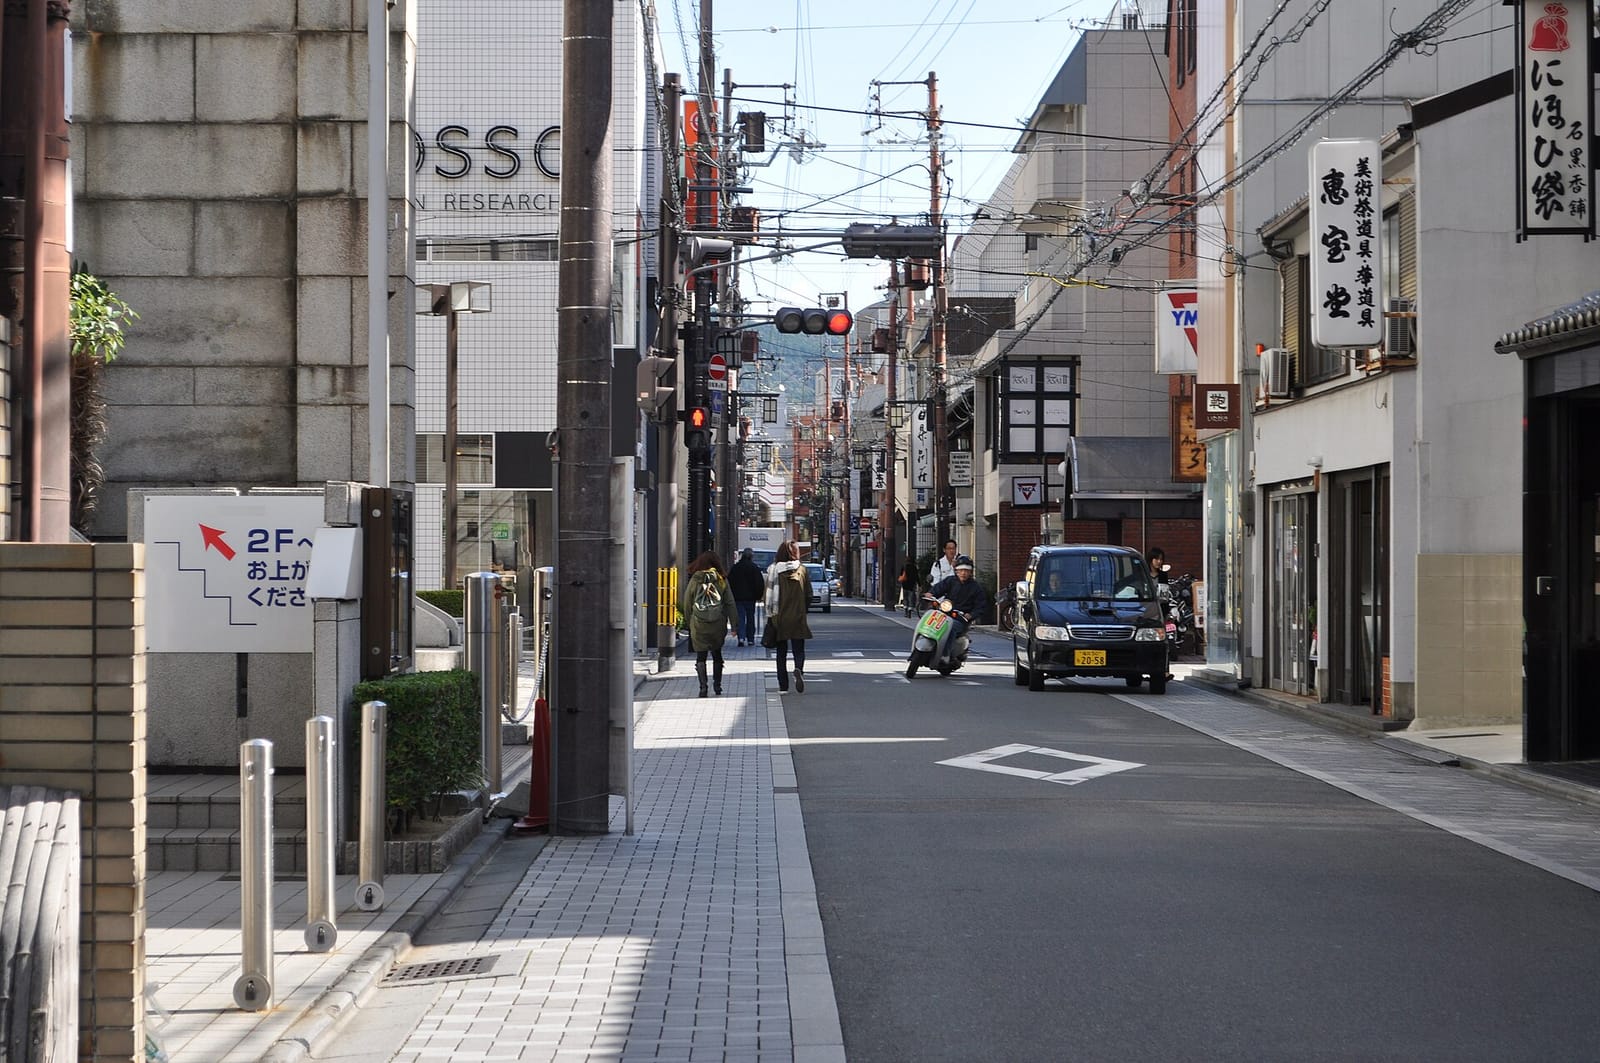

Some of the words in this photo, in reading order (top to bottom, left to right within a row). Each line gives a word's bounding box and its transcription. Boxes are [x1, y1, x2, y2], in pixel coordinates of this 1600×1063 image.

[1530, 58, 1566, 221] にほひ袋
[1565, 119, 1587, 219] 石黒香舗
[1209, 393, 1228, 410] 鞄
[1081, 656, 1105, 665] 20-58
